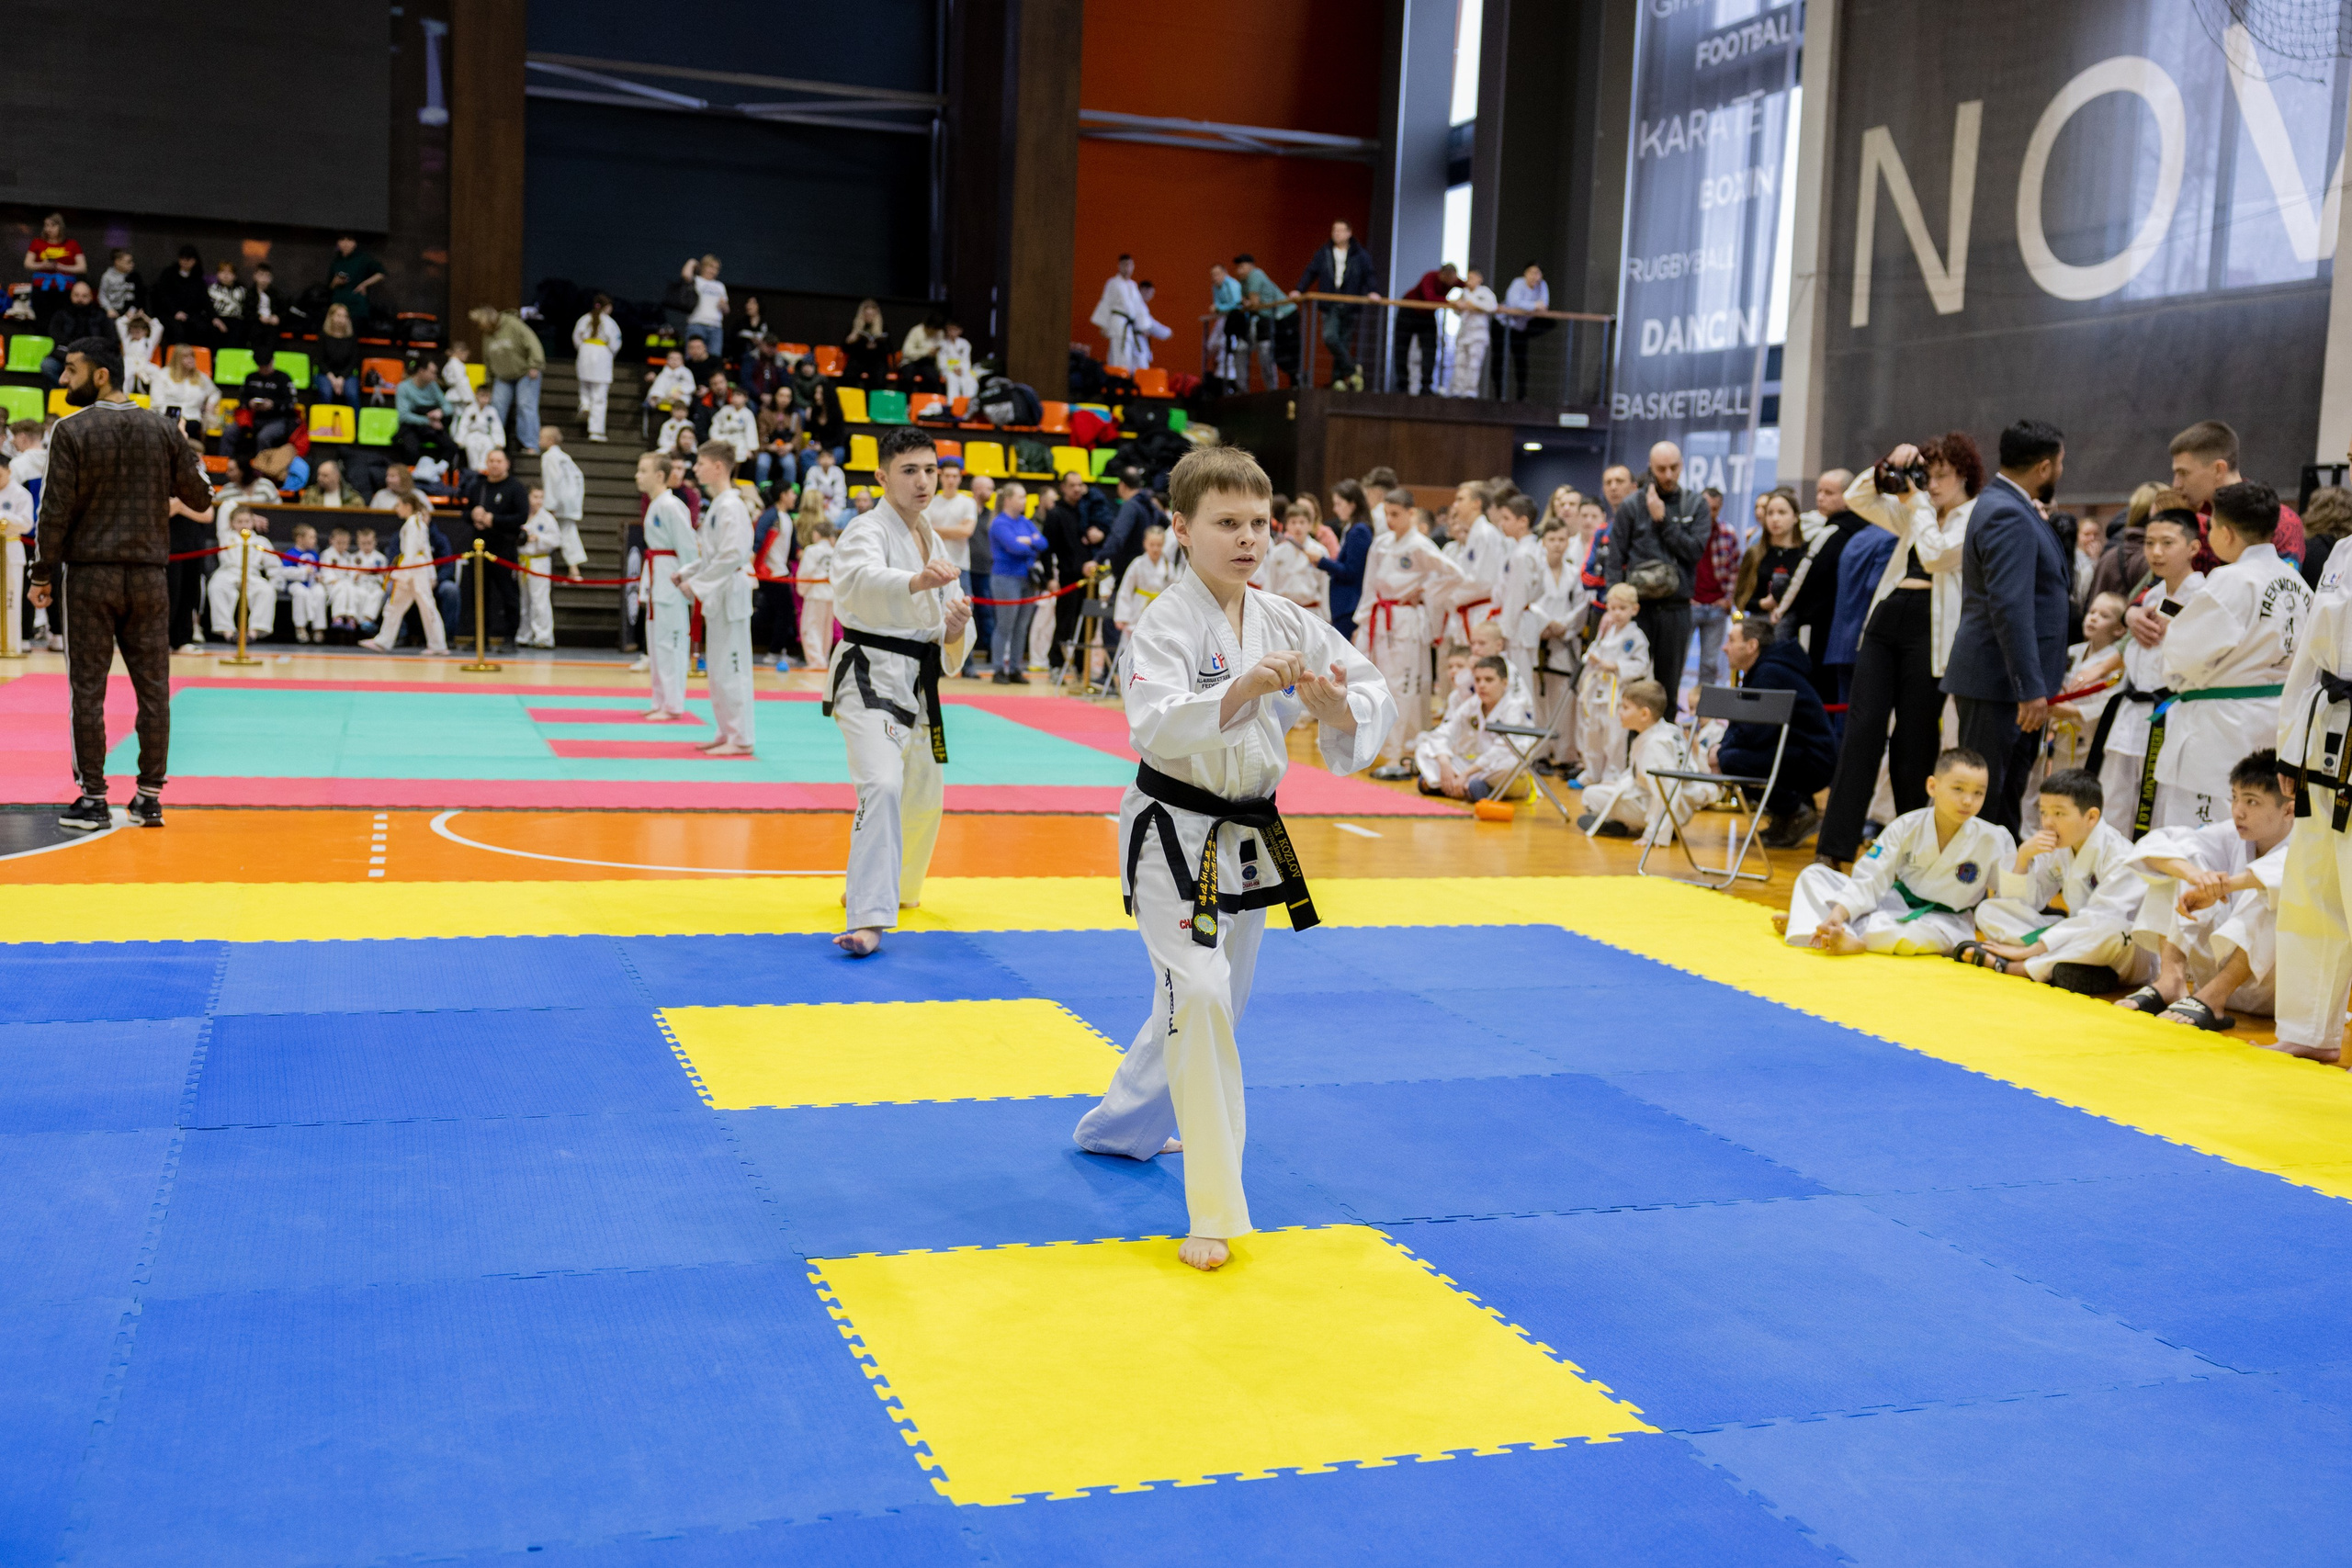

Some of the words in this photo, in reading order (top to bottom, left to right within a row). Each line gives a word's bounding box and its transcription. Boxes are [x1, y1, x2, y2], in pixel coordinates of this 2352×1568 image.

[1638, 89, 1766, 159] KARATE
[1626, 243, 1735, 283] RUGBYBALL
[1610, 385, 1750, 421] BASKETBALL
[2259, 577, 2312, 622] TAEKWON-D
[1278, 838, 1302, 878] KOZLOV
